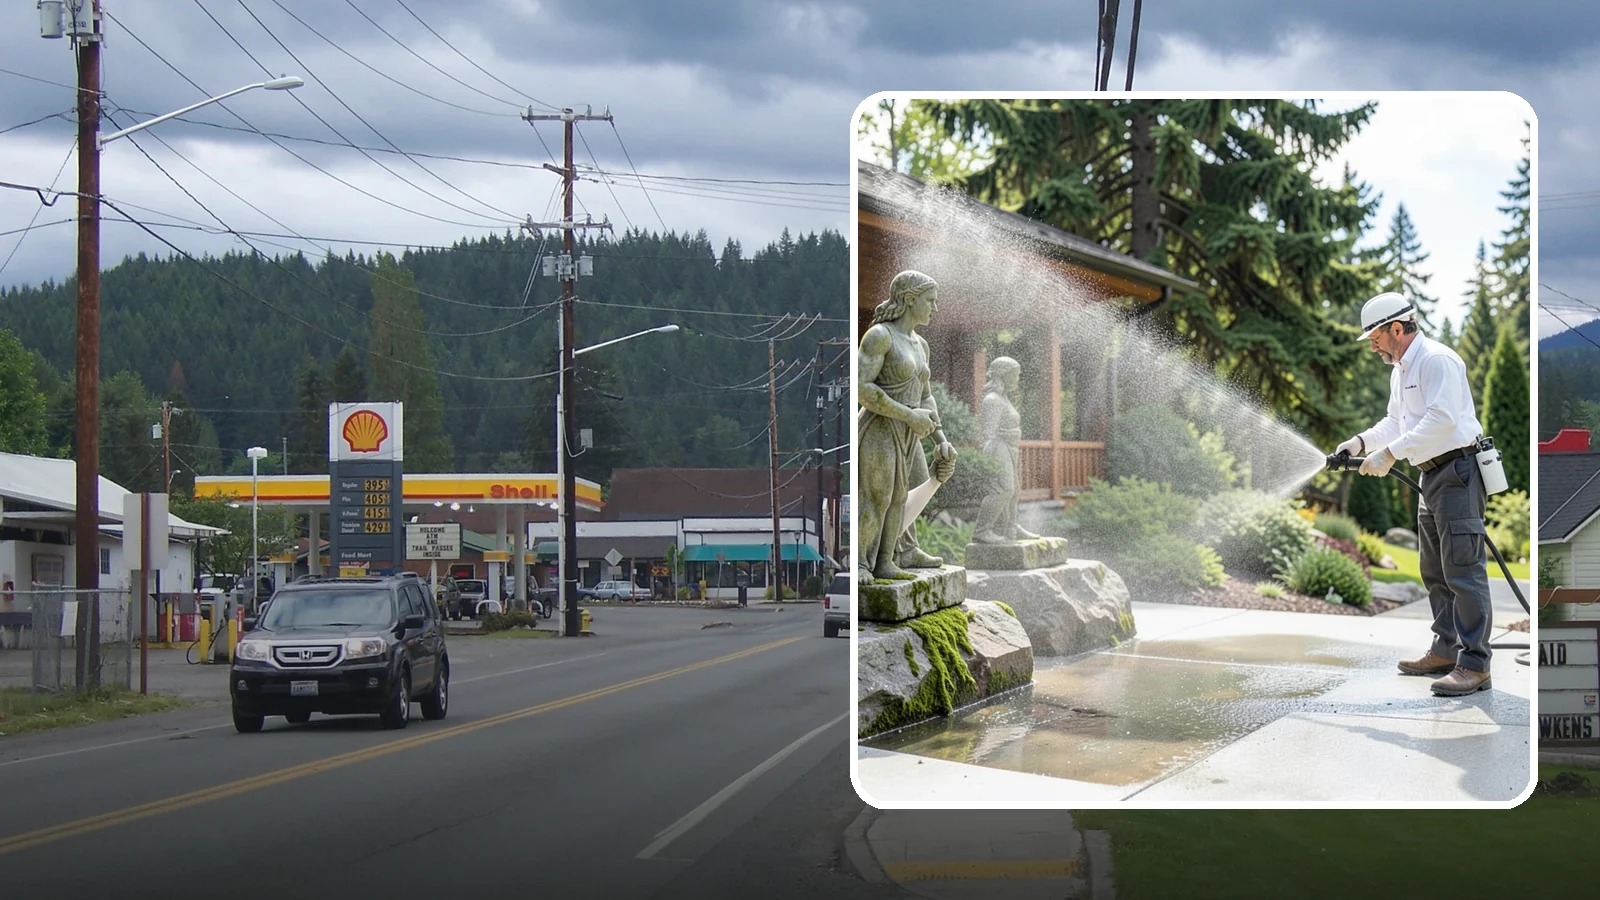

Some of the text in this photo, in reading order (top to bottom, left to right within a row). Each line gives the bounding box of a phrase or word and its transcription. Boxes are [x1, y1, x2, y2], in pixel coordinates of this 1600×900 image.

[366, 480, 384, 490] 395
[490, 484, 547, 499] Shell
[366, 494, 384, 504] 405
[366, 508, 384, 518] 415
[366, 522, 384, 532] 429
